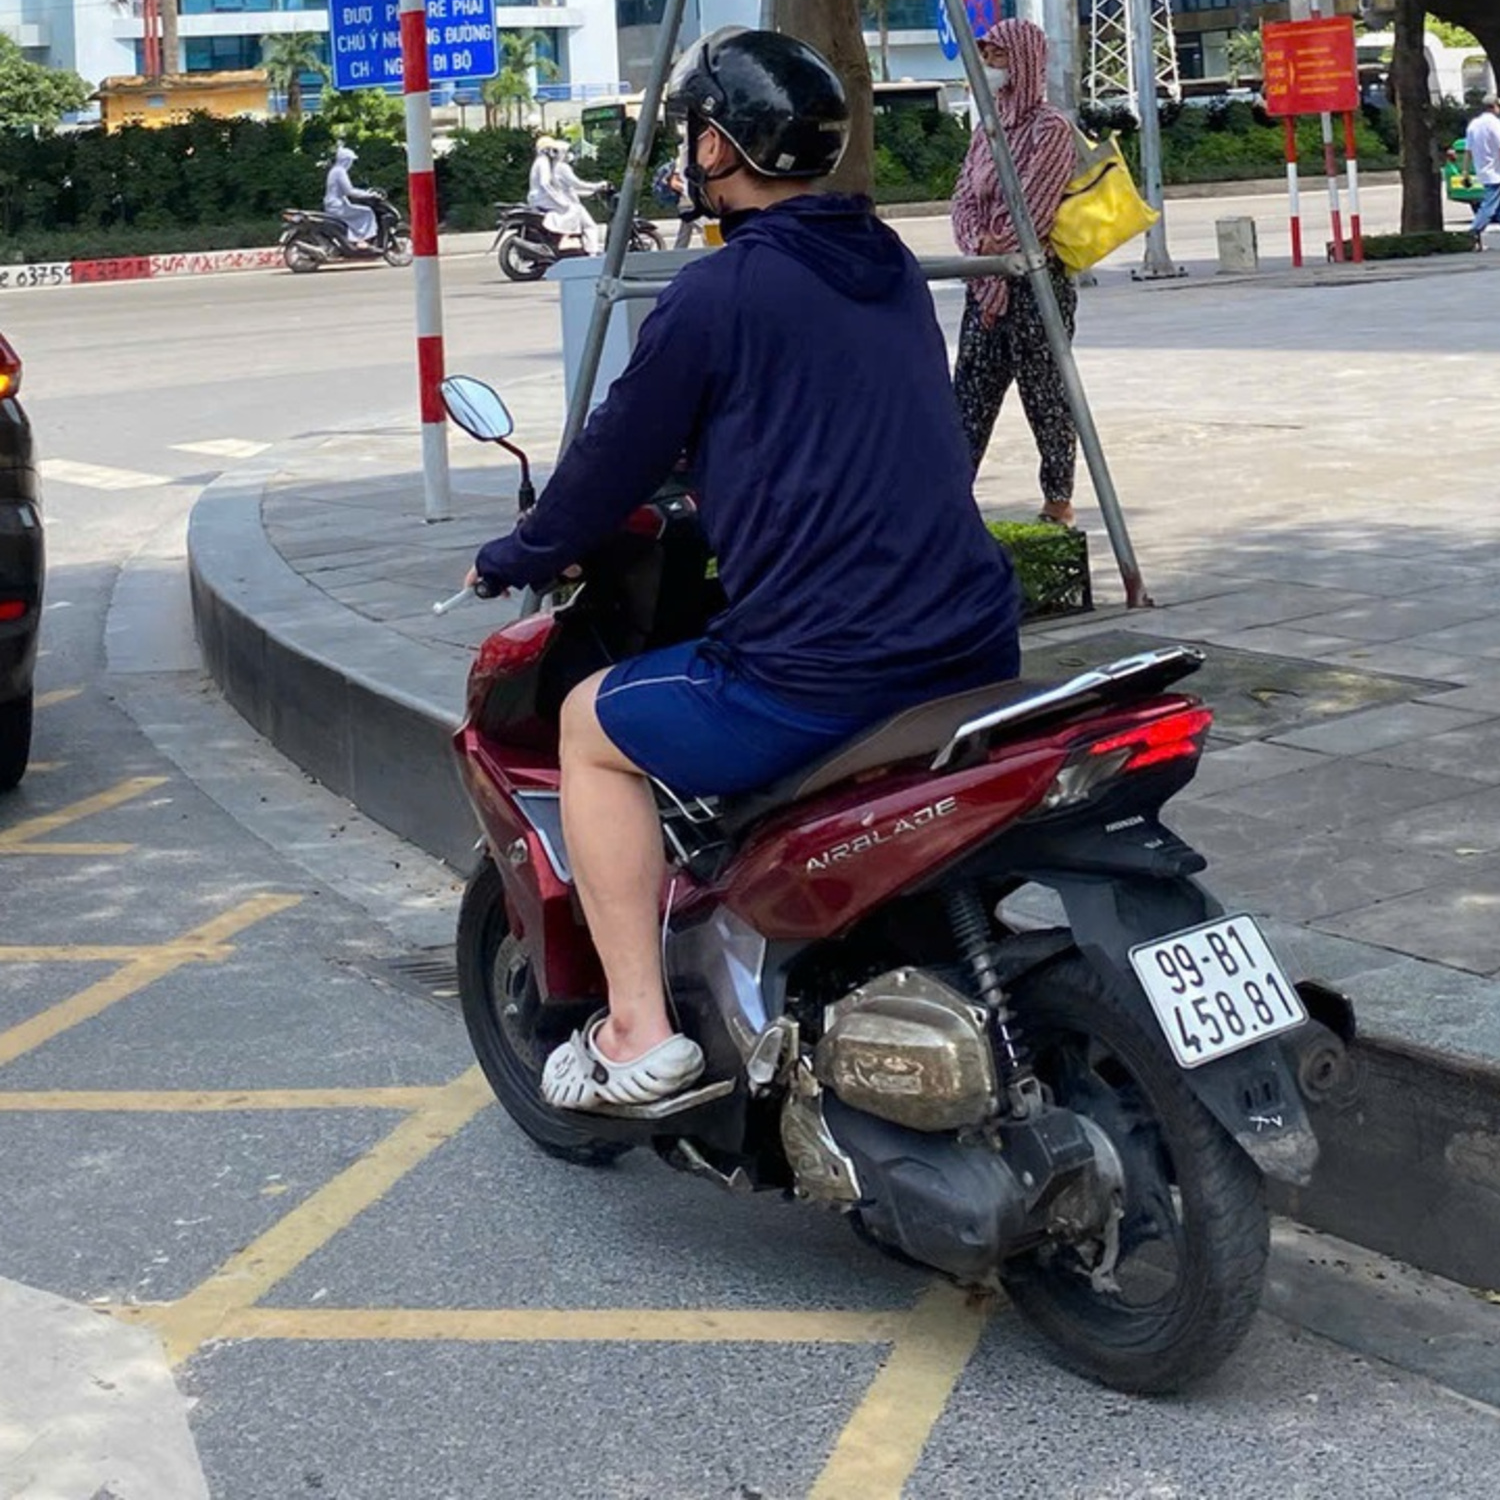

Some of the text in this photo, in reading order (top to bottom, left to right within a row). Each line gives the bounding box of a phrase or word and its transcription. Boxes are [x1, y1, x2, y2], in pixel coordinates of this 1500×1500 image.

[337, 28, 366, 53] CHÚ
[368, 28, 379, 51] Ý
[432, 53, 448, 72] ĐI
[452, 49, 472, 72] BỘ
[806, 795, 958, 875] AIRBLADE
[1154, 924, 1257, 995] 99-B1
[1173, 971, 1294, 1053] 458.81
